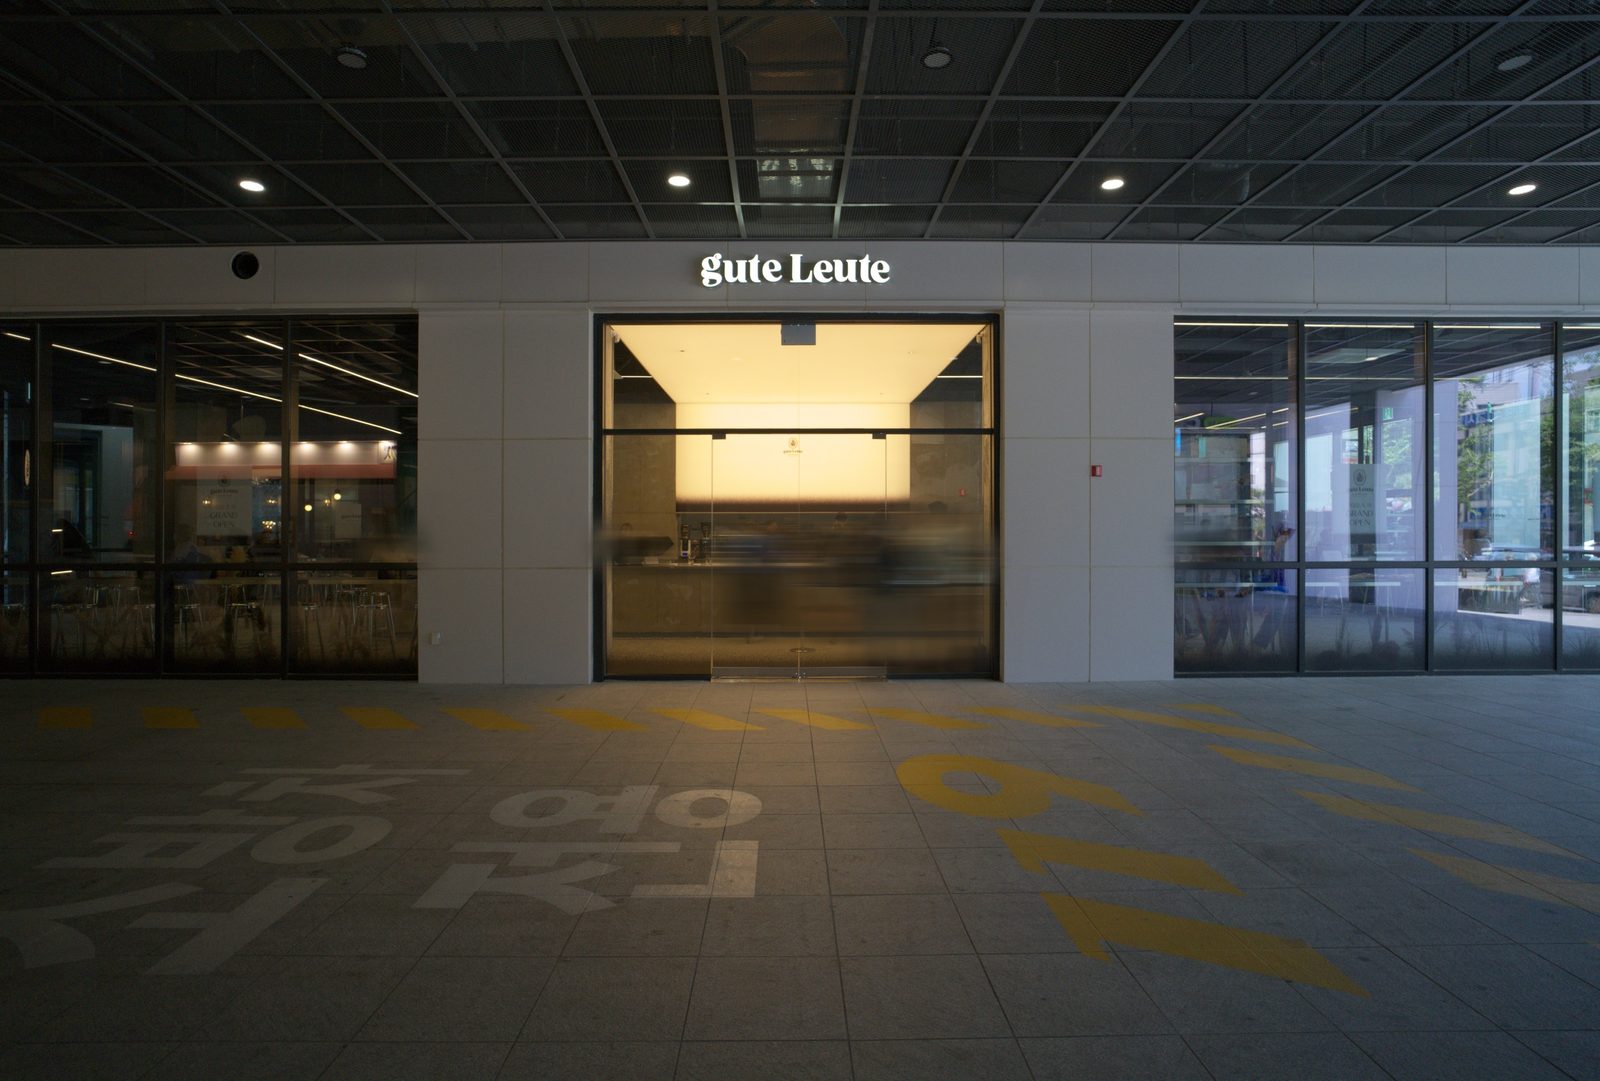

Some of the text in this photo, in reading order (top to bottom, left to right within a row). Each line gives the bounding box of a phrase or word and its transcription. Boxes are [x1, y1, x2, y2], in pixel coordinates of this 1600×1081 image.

[701, 252, 890, 287] gute Leute
[411, 784, 764, 914] 전용
